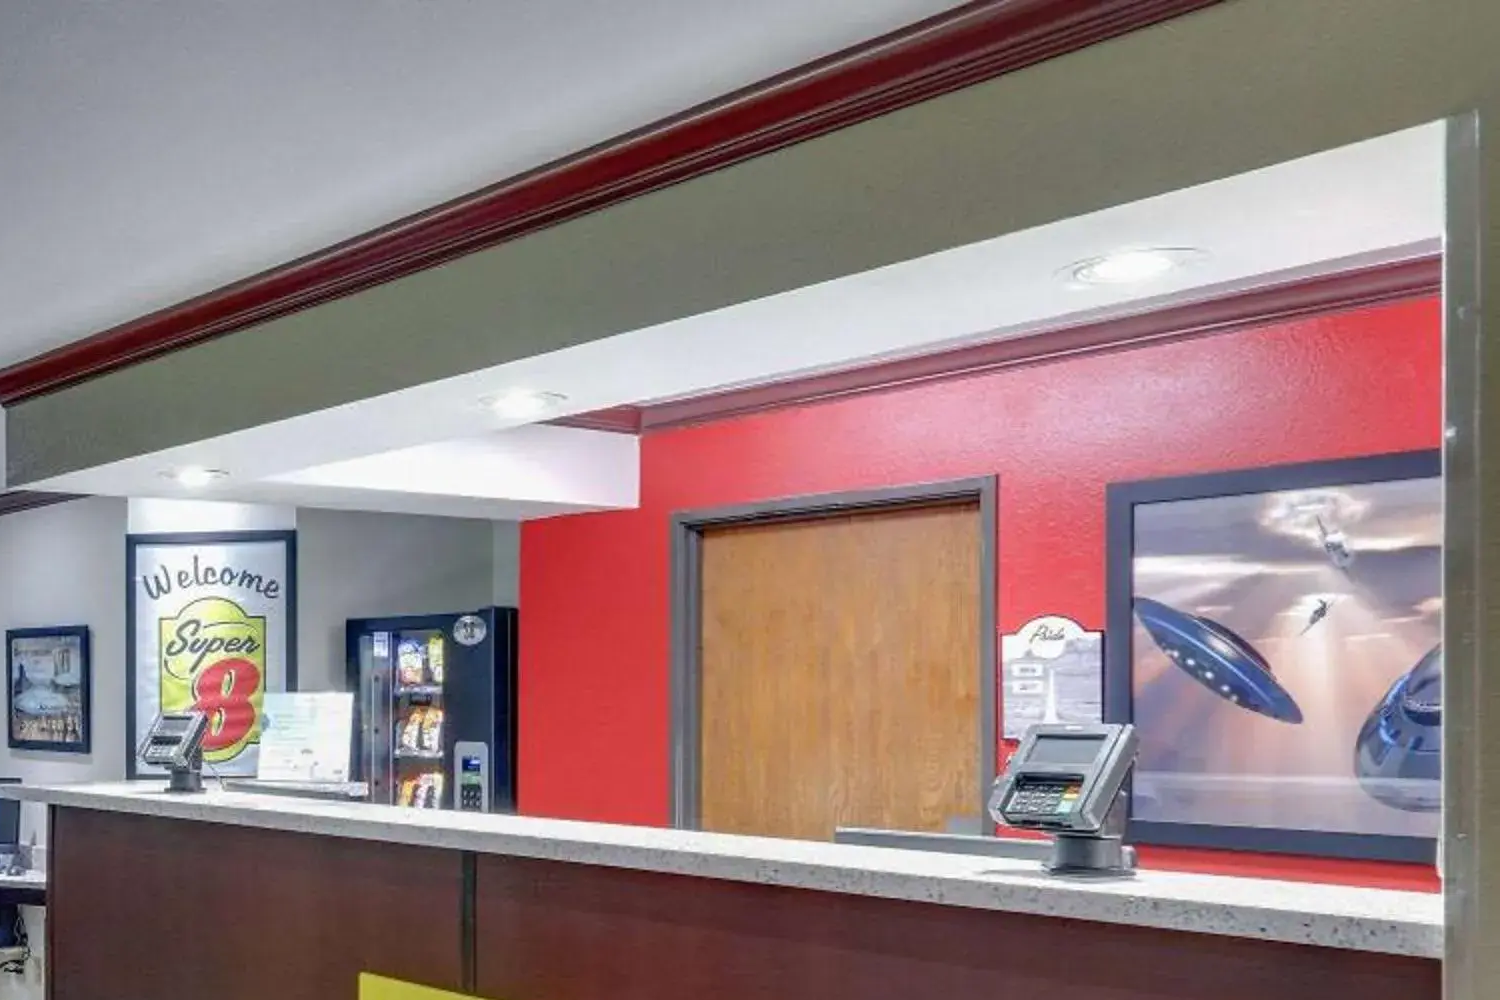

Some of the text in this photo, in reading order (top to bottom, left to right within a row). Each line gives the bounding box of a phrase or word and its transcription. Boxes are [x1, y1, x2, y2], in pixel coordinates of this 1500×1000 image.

[143, 555, 280, 600] Welcome
[166, 618, 260, 674] Super
[192, 657, 260, 752] 8
